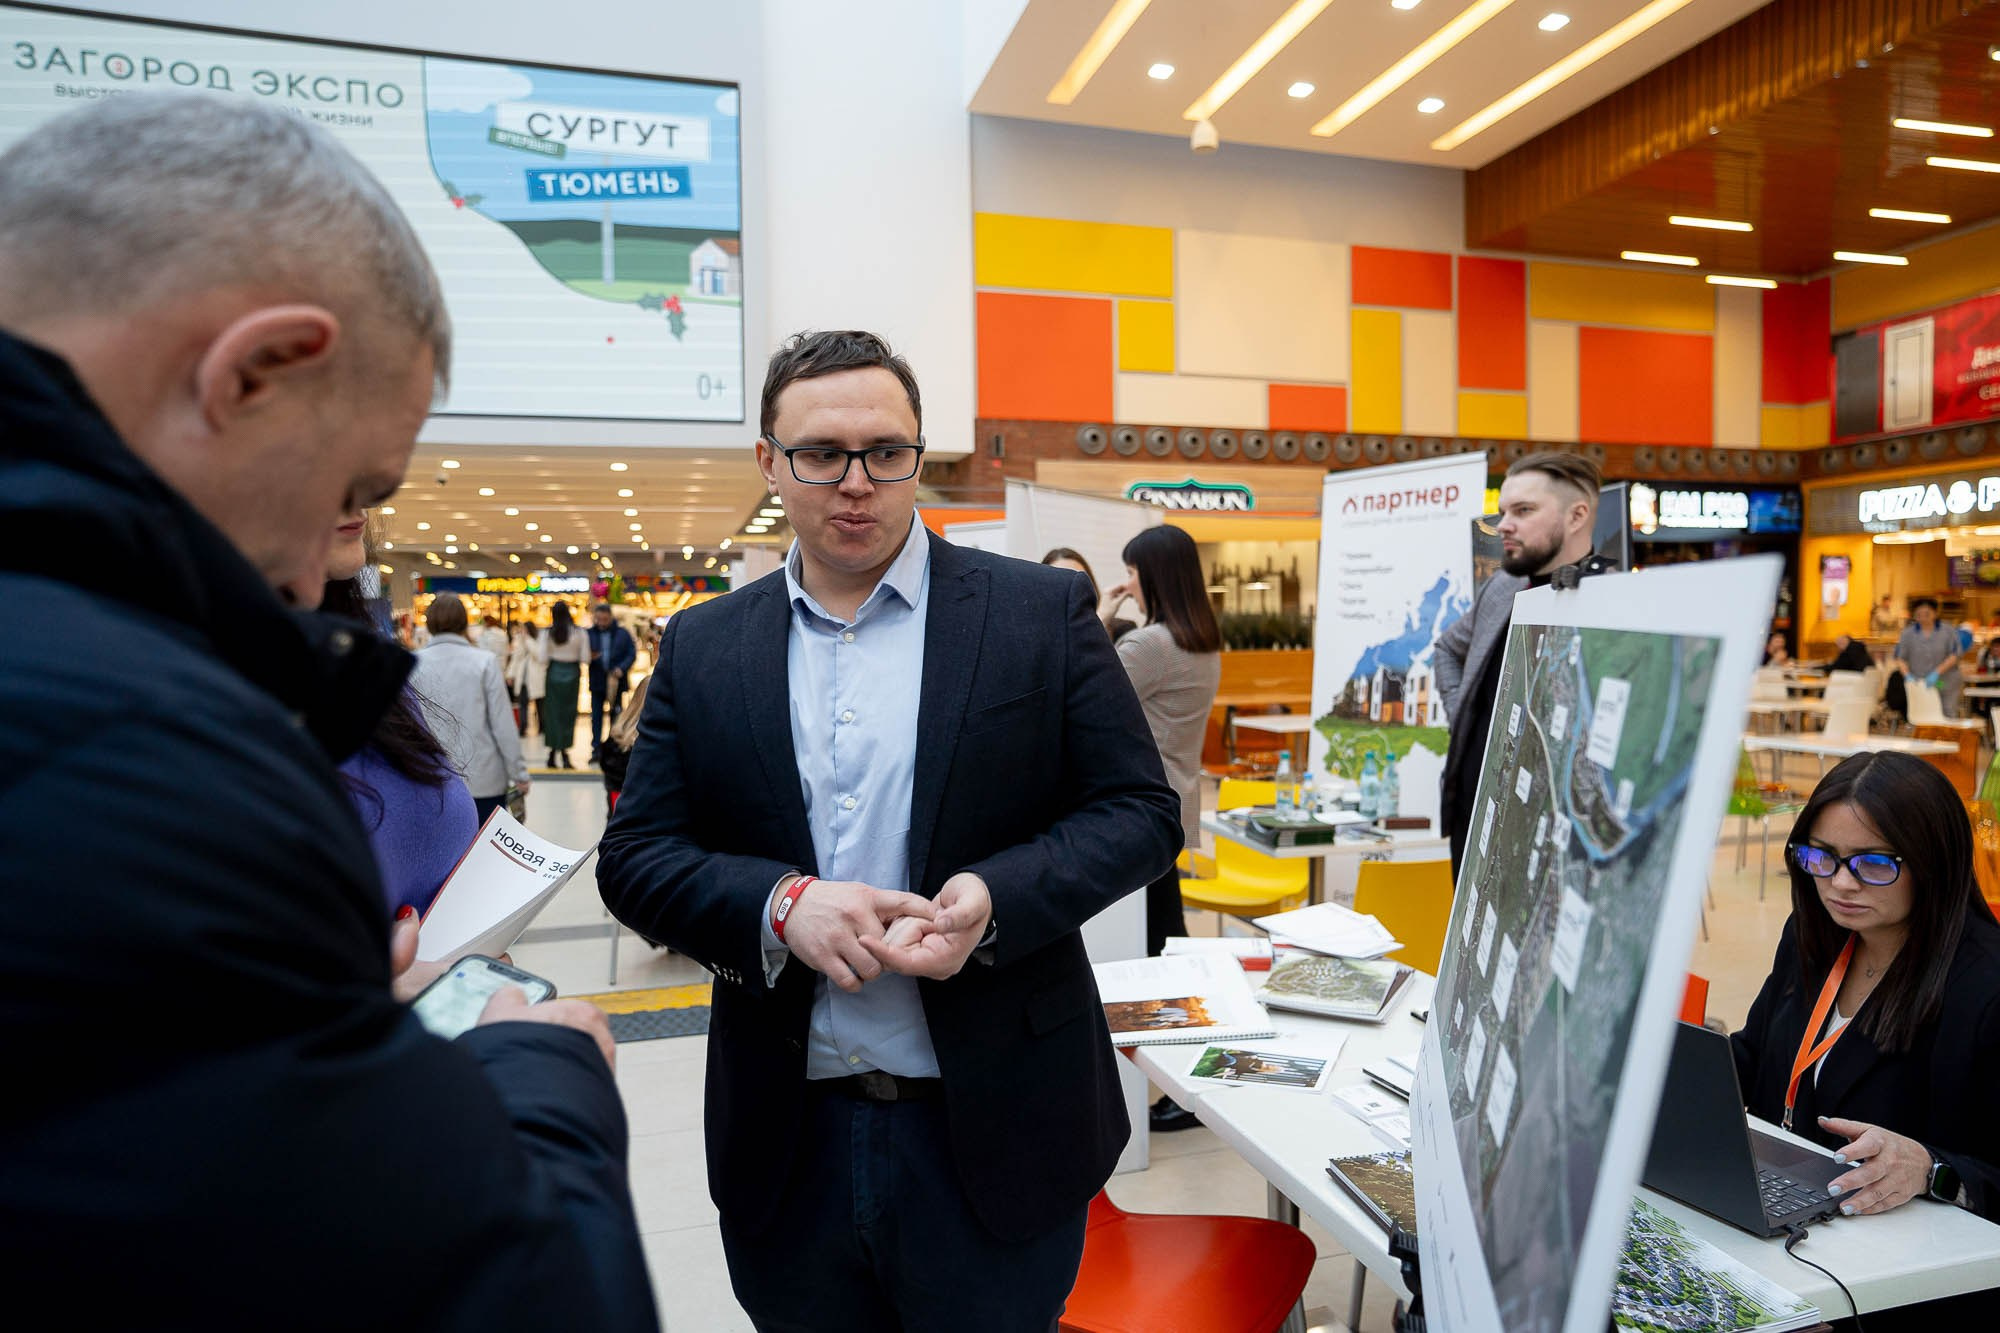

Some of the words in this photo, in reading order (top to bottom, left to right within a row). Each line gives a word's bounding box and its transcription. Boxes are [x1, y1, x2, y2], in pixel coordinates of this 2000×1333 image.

[14, 41, 233, 92] ЗАГОРОД
[251, 70, 404, 109] ЭКСПО
[527, 112, 680, 149] СУРГУТ
[538, 170, 680, 197] ТЮМЕНЬ
[1363, 484, 1460, 513] партнер
[1858, 484, 1947, 522] PIZZA
[495, 827, 546, 867] новая
[548, 861, 573, 874] зе
[780, 902, 789, 916] 598
